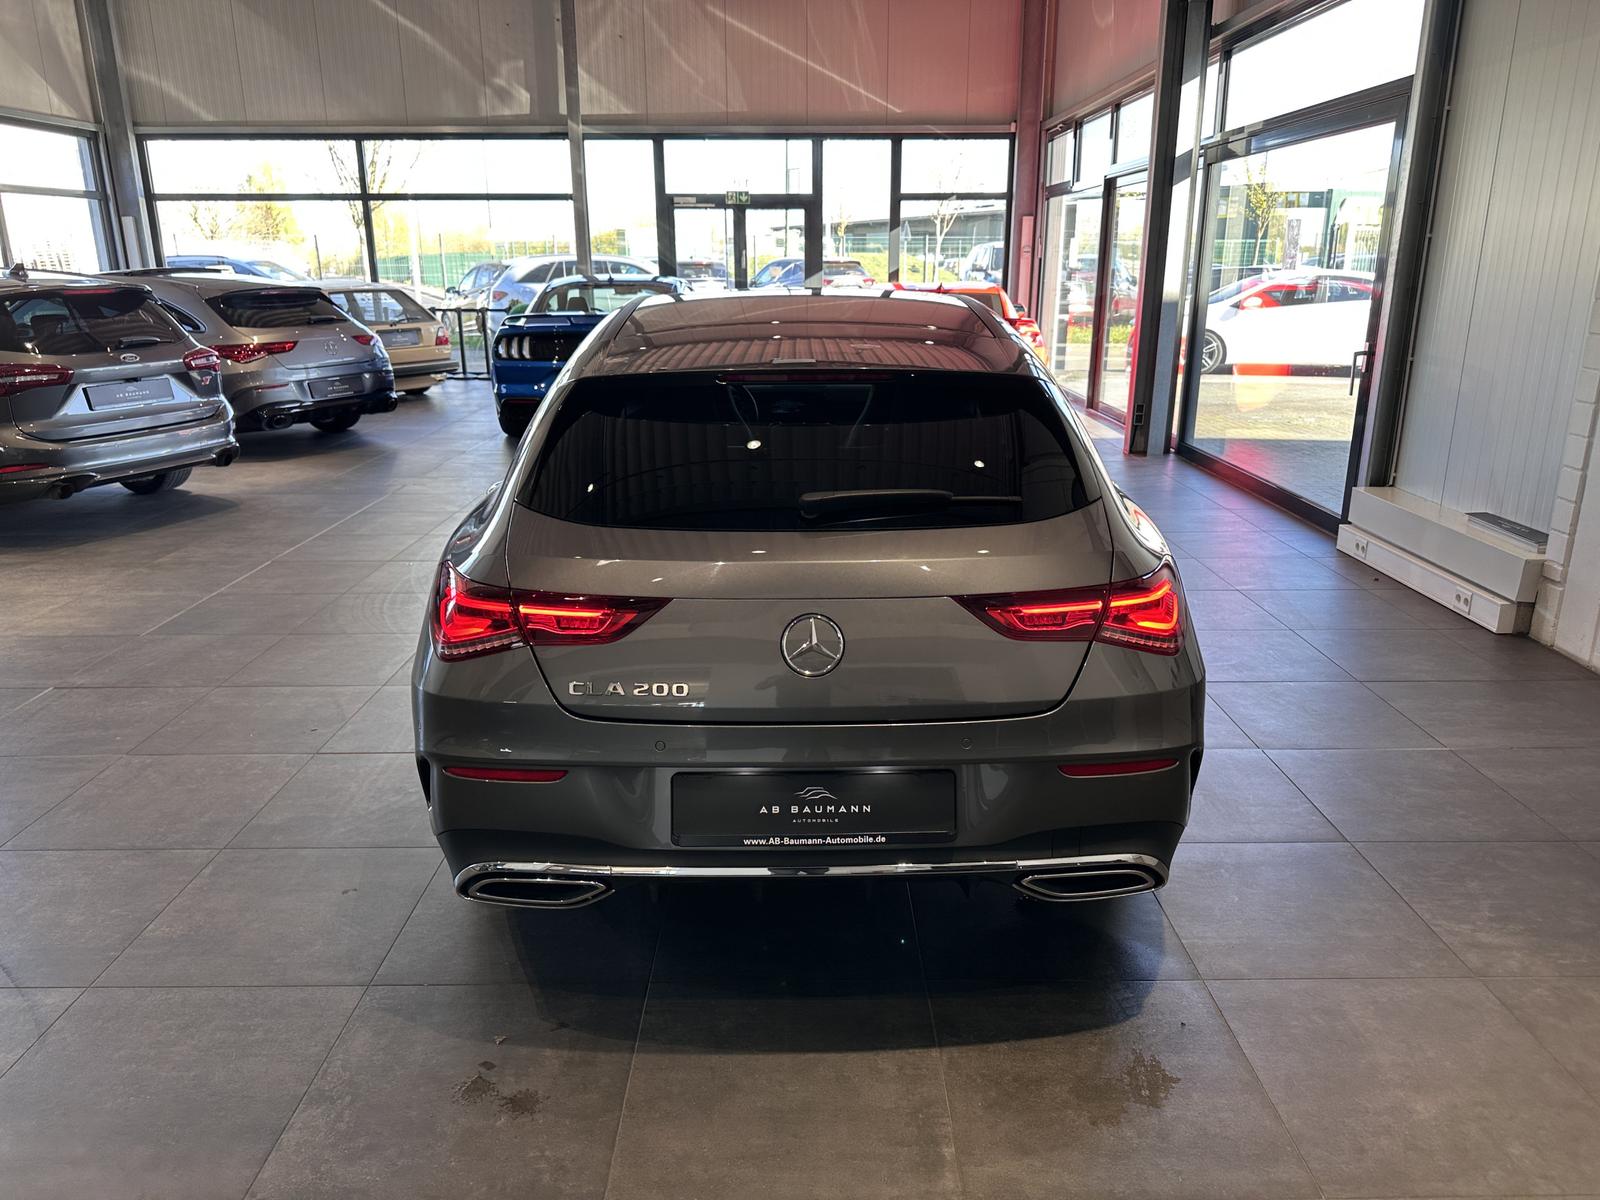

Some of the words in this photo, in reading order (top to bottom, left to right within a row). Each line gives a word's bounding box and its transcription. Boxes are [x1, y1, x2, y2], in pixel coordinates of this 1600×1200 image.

[568, 681, 626, 697] CLA
[632, 682, 689, 697] 200
[759, 805, 780, 814] AB
[790, 804, 872, 814] BAUMANN
[743, 834, 887, 846] www.AB-Baumann-Automobile.de
